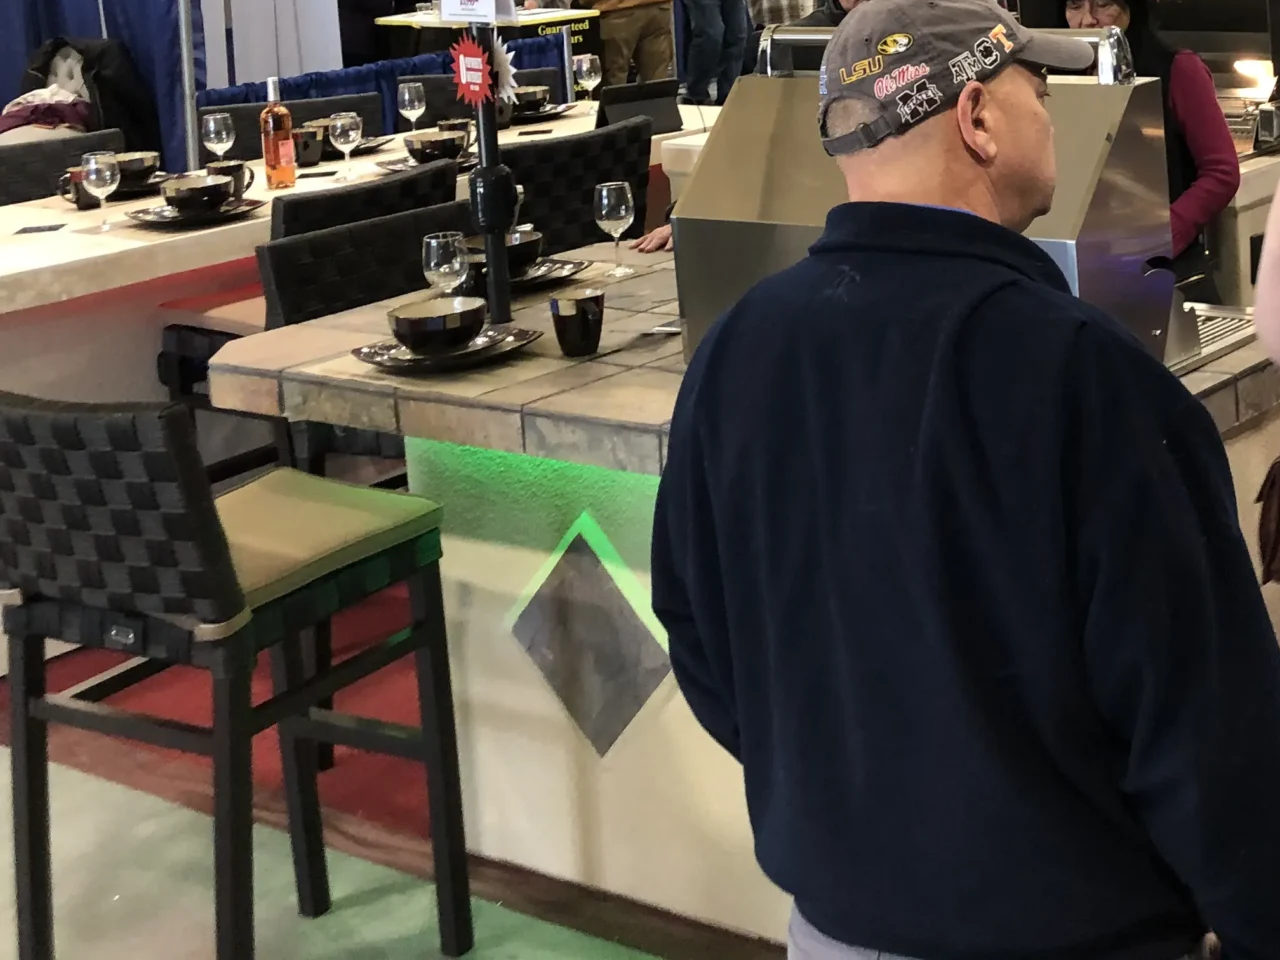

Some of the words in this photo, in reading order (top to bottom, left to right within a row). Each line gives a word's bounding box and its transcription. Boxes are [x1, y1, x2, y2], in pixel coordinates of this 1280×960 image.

[538, 20, 590, 36] Guarteed
[839, 55, 883, 84] LSU
[874, 74, 896, 100] Ole
[891, 62, 930, 87] Miss
